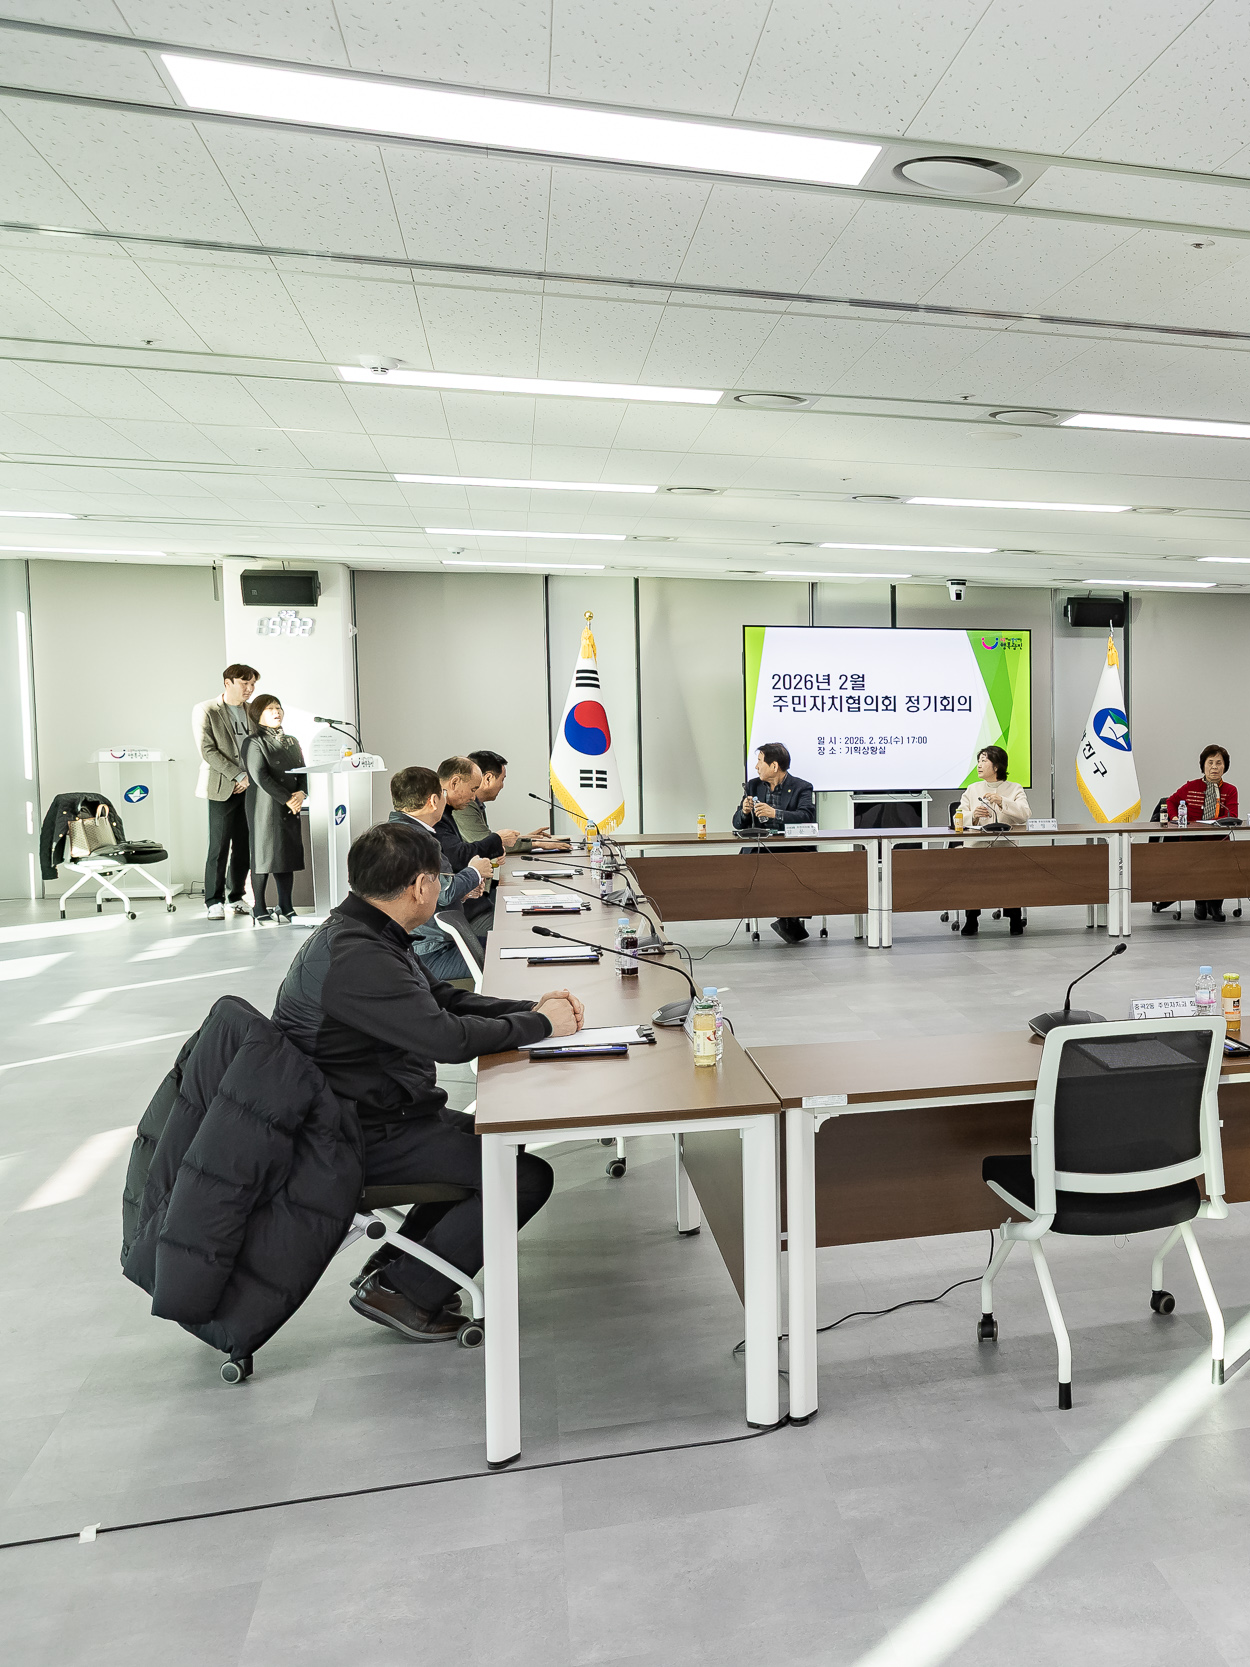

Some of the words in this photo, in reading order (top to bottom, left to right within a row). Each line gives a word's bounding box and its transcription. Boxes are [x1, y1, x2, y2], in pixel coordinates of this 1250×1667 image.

[771, 673, 831, 691] 2026년
[838, 673, 866, 691] 2월
[772, 695, 897, 713] 주민자치협의회
[905, 695, 973, 713] 정기회의
[817, 736, 825, 745] 일
[844, 736, 866, 745] 2026.
[907, 736, 928, 745] 17:00
[817, 746, 825, 755] 장
[829, 746, 837, 755] 소
